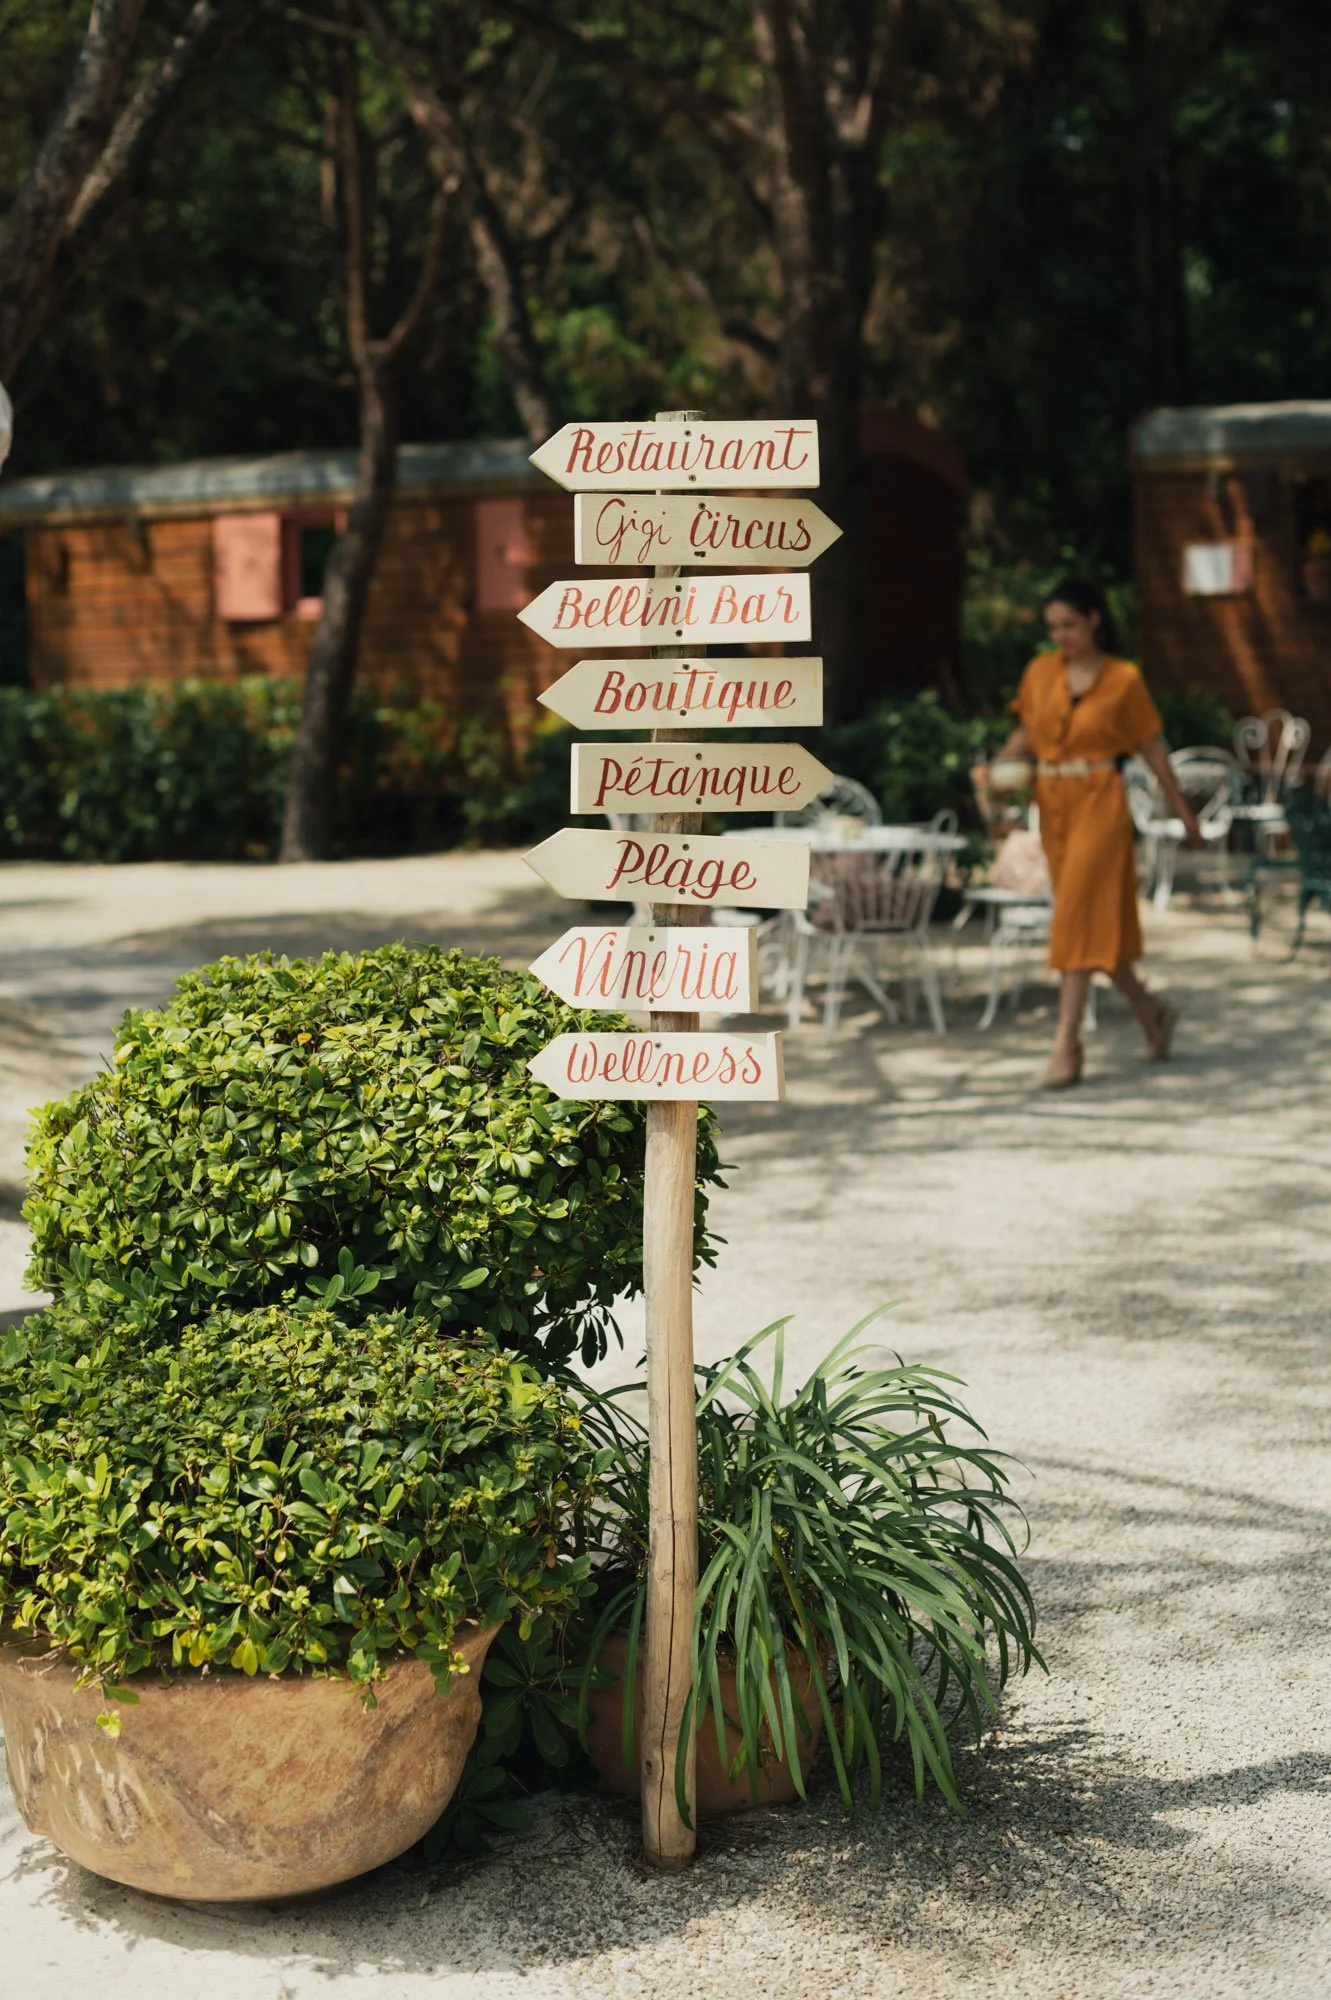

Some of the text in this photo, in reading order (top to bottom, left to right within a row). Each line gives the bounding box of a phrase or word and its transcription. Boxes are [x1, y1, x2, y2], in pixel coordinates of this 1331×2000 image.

[565, 427, 812, 473] Restaurant
[595, 498, 811, 563] Gigi Circus
[552, 584, 799, 629] Bellini Bar
[593, 669, 796, 722] Boutique
[592, 756, 801, 806] Pétanque
[605, 839, 757, 899] Plage
[558, 931, 738, 1000] Vineria
[566, 1039, 762, 1084] Wellness
